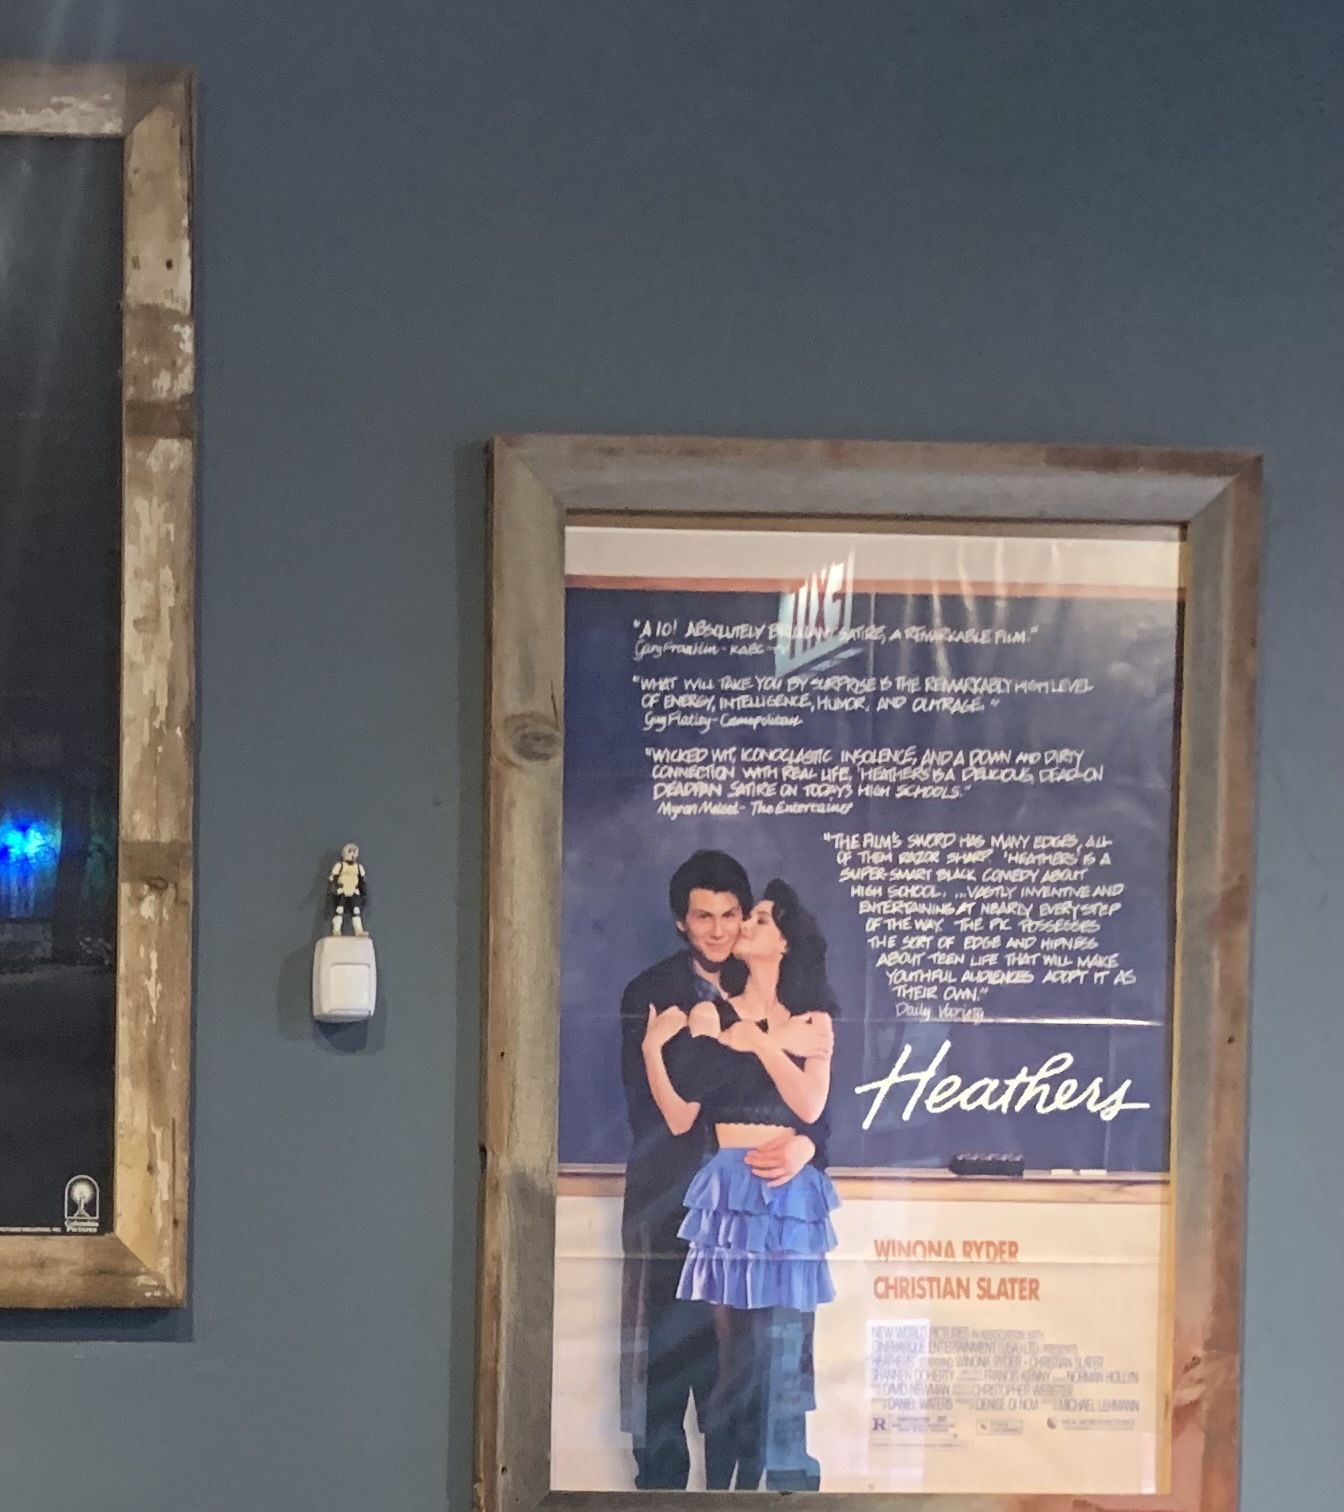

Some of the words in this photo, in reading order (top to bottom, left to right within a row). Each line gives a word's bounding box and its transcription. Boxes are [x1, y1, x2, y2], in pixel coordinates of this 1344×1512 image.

[655, 619, 678, 637] 10!
[685, 619, 765, 640] ABSOLUTELY
[889, 626, 901, 642] A
[904, 625, 991, 644] REMARKABLE
[684, 677, 715, 692] WILL
[719, 676, 752, 692] TAKE
[755, 675, 783, 692] YOU
[787, 676, 809, 692] BY
[810, 674, 877, 694] SURPRISE
[880, 676, 893, 692] IS
[895, 675, 921, 693] THE
[924, 675, 1011, 694] REMARKABLY
[1014, 680, 1049, 694] HIGH
[1050, 678, 1094, 694] LEVEL
[641, 695, 660, 709] OF
[876, 695, 907, 712] AND
[643, 712, 667, 733] Guy
[740, 747, 832, 765] ICONOCLASTIC
[920, 748, 952, 766] AND
[953, 749, 965, 766] A
[969, 748, 1011, 766] DOWN
[1015, 750, 1042, 764] AND
[1044, 748, 1085, 770] DIRTY
[652, 764, 735, 780] CONNECTION
[741, 766, 779, 780] WITH
[782, 766, 817, 781] REAL
[653, 781, 722, 800] DEADPAN
[727, 780, 777, 798] SATIRE
[780, 783, 798, 798] ON
[858, 784, 890, 799] HIGH
[750, 801, 773, 816] The
[907, 832, 956, 849] SWORD
[959, 832, 985, 849] HAS
[991, 832, 1031, 850] MANY
[1085, 834, 1113, 849] ALL
[836, 850, 853, 866] OF
[857, 850, 893, 865] THEM
[898, 849, 940, 865] RAZOR
[1083, 852, 1096, 866] IS
[1099, 852, 1111, 866] A
[838, 866, 933, 883] SUPER-SMART
[936, 867, 977, 882] BLACK
[982, 867, 1040, 883] COMEDY
[1040, 868, 1088, 884] ABOUT
[850, 884, 883, 898] HIGH
[1020, 885, 1090, 899] INVENTIVE
[1092, 883, 1125, 898] AND
[859, 900, 956, 916] ENTERTAINING
[956, 901, 977, 915] AT
[980, 900, 1034, 918] NEARLY
[1039, 900, 1079, 920] EVERY
[1080, 902, 1122, 917] STEP
[865, 917, 883, 932] OF
[883, 916, 912, 932] THE
[953, 917, 984, 932] THE
[989, 917, 1012, 931] PIC
[1018, 918, 1101, 934] POSSESSES
[867, 934, 898, 949] THE
[901, 935, 934, 950] SORT
[937, 936, 955, 950] OF
[963, 935, 1002, 950] EDGE
[1006, 936, 1037, 949] AND
[1040, 936, 1099, 951] HIPNESS
[875, 951, 926, 967] ABOUT
[927, 951, 965, 966] TEEN
[970, 952, 999, 967] LIFE
[1004, 952, 1041, 967] THAT
[1042, 953, 1074, 967] WILL
[1077, 952, 1119, 969] MAKE
[885, 968, 957, 985] YOUTHFUL
[961, 969, 1035, 985] AUDIENCES
[1041, 969, 1089, 985] ADOPT
[1093, 970, 1111, 985] IT
[1113, 968, 1137, 986] AS
[892, 984, 938, 1000] THEIR
[895, 1001, 931, 1022] Daily
[853, 1039, 1151, 1131] Heathers
[873, 1238, 957, 1260] WINONA
[961, 1239, 1020, 1263] RYDER
[873, 1275, 971, 1301] CHRISTIAN
[976, 1276, 1041, 1302] SLATER
